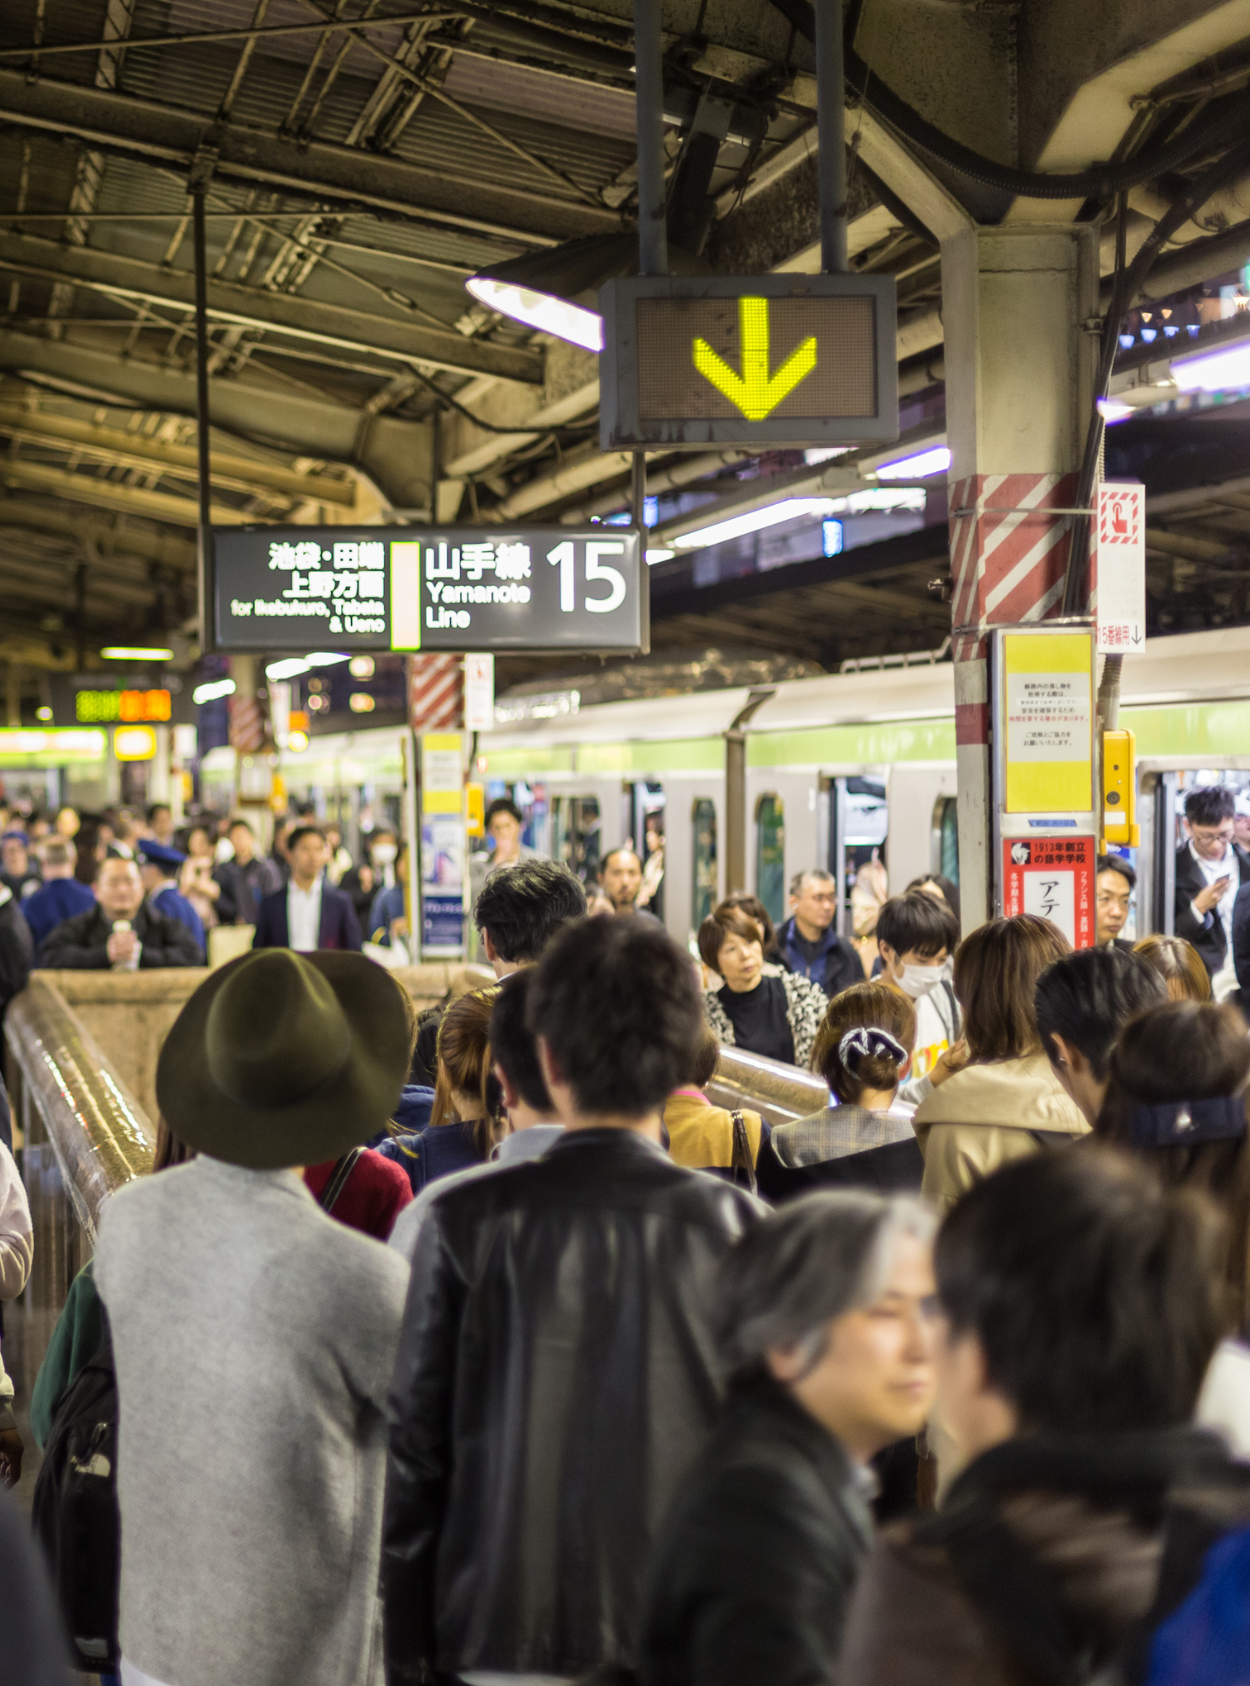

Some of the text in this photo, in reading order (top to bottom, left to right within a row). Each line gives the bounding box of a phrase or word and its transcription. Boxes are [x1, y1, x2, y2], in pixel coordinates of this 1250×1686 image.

[268, 541, 385, 570] 池袋・田端
[425, 542, 531, 580] 山手線
[282, 570, 385, 598] 上野方面
[546, 541, 626, 613] 15
[425, 581, 531, 603] Yamanote
[230, 598, 254, 616] for
[332, 598, 385, 616] Tabata
[425, 606, 471, 628] Line
[329, 615, 386, 633] & Ueno
[1034, 842, 1086, 852] 1913年創立
[1034, 854, 1086, 864] の語学学校
[1010, 872, 1019, 917] 冬学期生募
[1039, 881, 1060, 918] アテ
